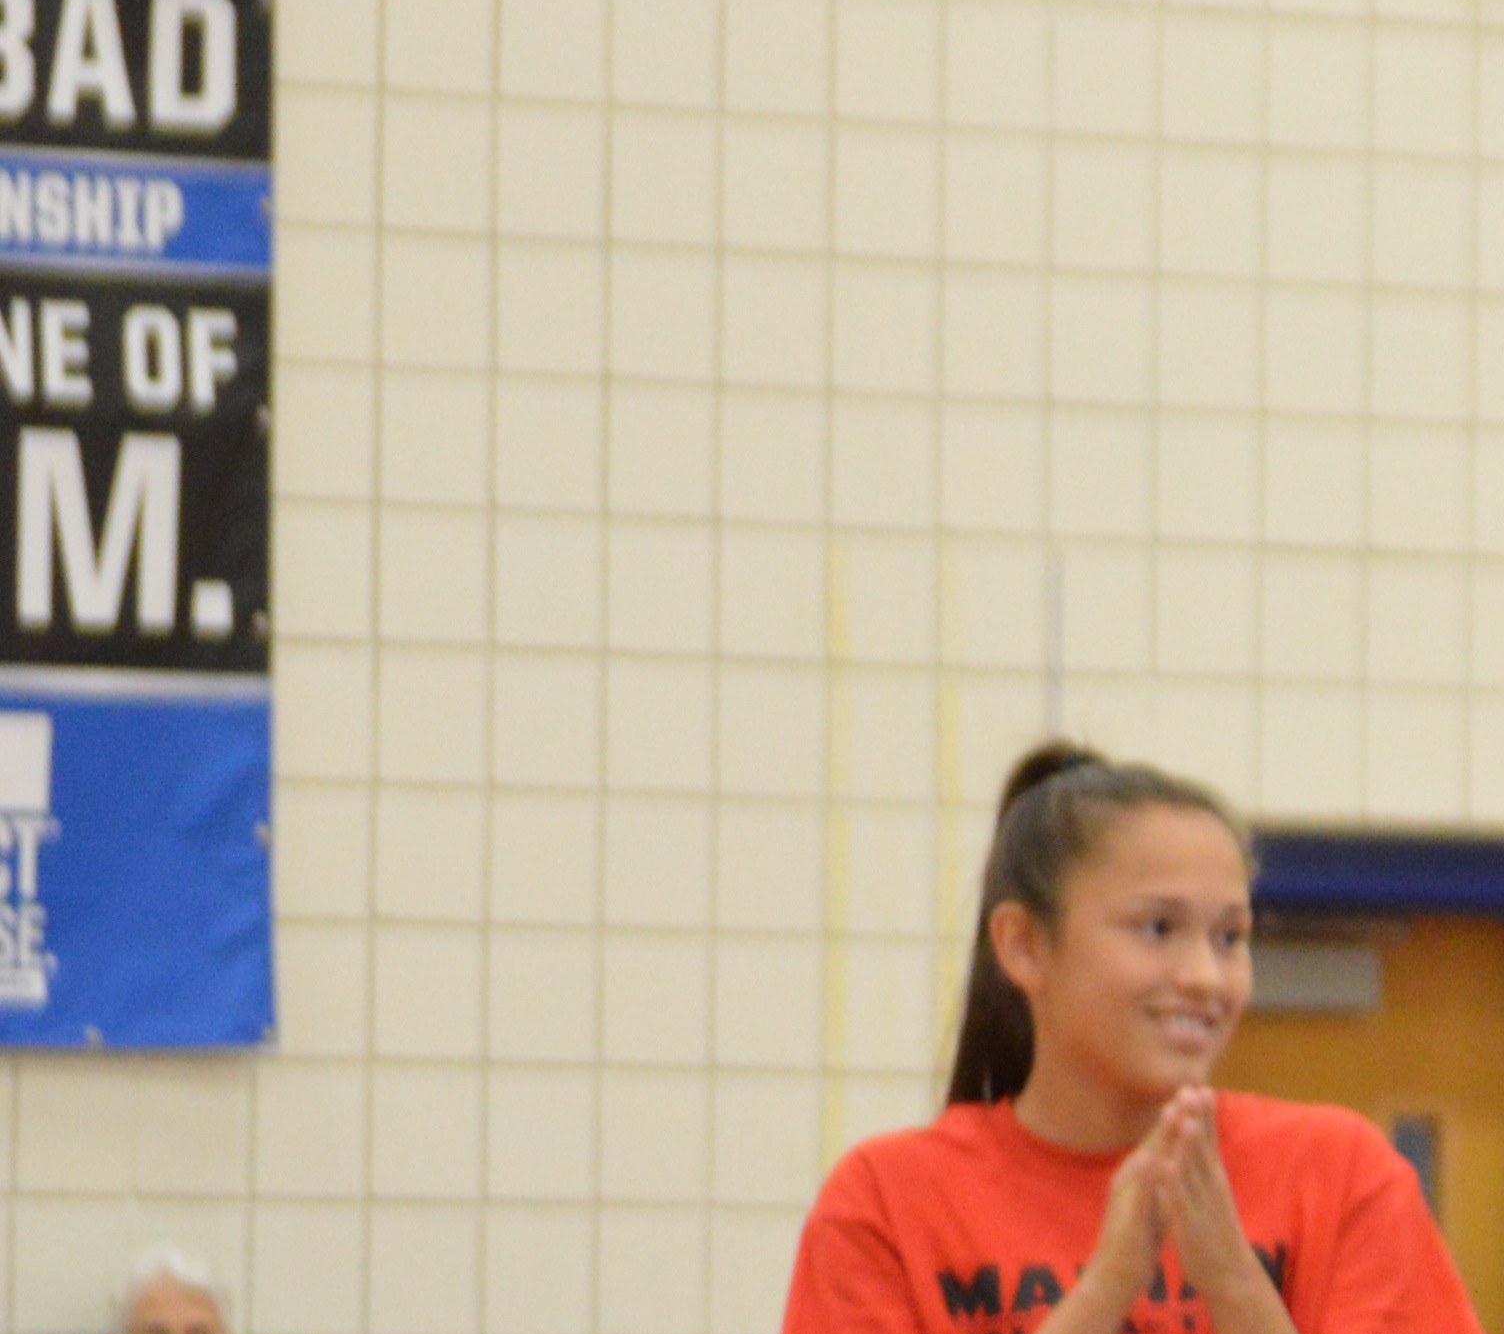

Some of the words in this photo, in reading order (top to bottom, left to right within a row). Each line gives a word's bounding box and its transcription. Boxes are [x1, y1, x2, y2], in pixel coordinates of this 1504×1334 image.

[0, 169, 185, 255] NSHIP
[123, 304, 240, 417] OF
[15, 425, 235, 638] M.
